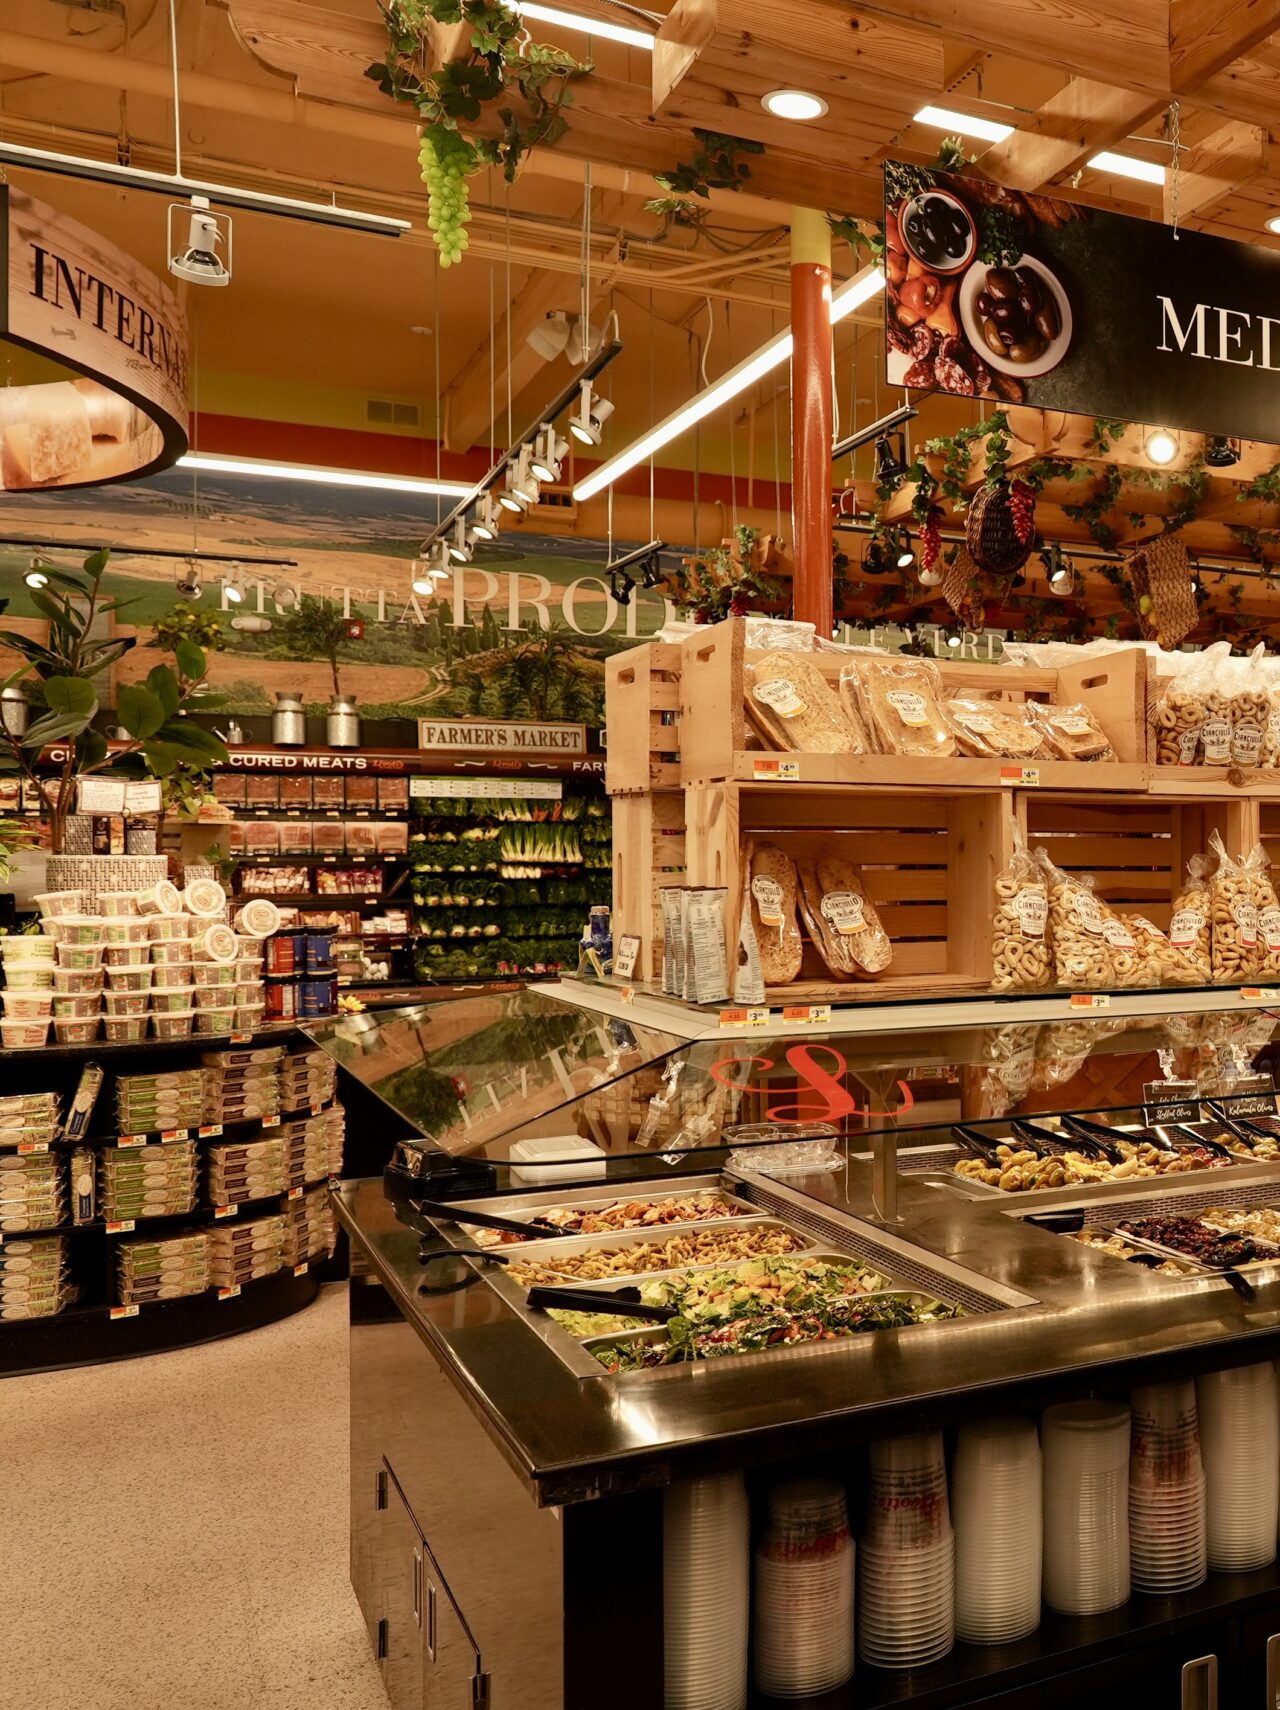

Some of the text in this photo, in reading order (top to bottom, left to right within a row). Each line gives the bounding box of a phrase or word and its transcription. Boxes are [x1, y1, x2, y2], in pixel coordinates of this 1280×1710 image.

[426, 727, 581, 748] FARMER'S MARKET
[1202, 727, 1231, 737] CIANCIULLO
[1233, 732, 1263, 743] CIANCIULLO
[229, 756, 298, 768] CURED
[303, 757, 367, 769] MEATS
[573, 762, 607, 772] FAR
[824, 897, 859, 910] CIANCIULLO
[1018, 900, 1047, 912] CIANCIULLO
[1228, 1102, 1274, 1116] Kalamata Olives
